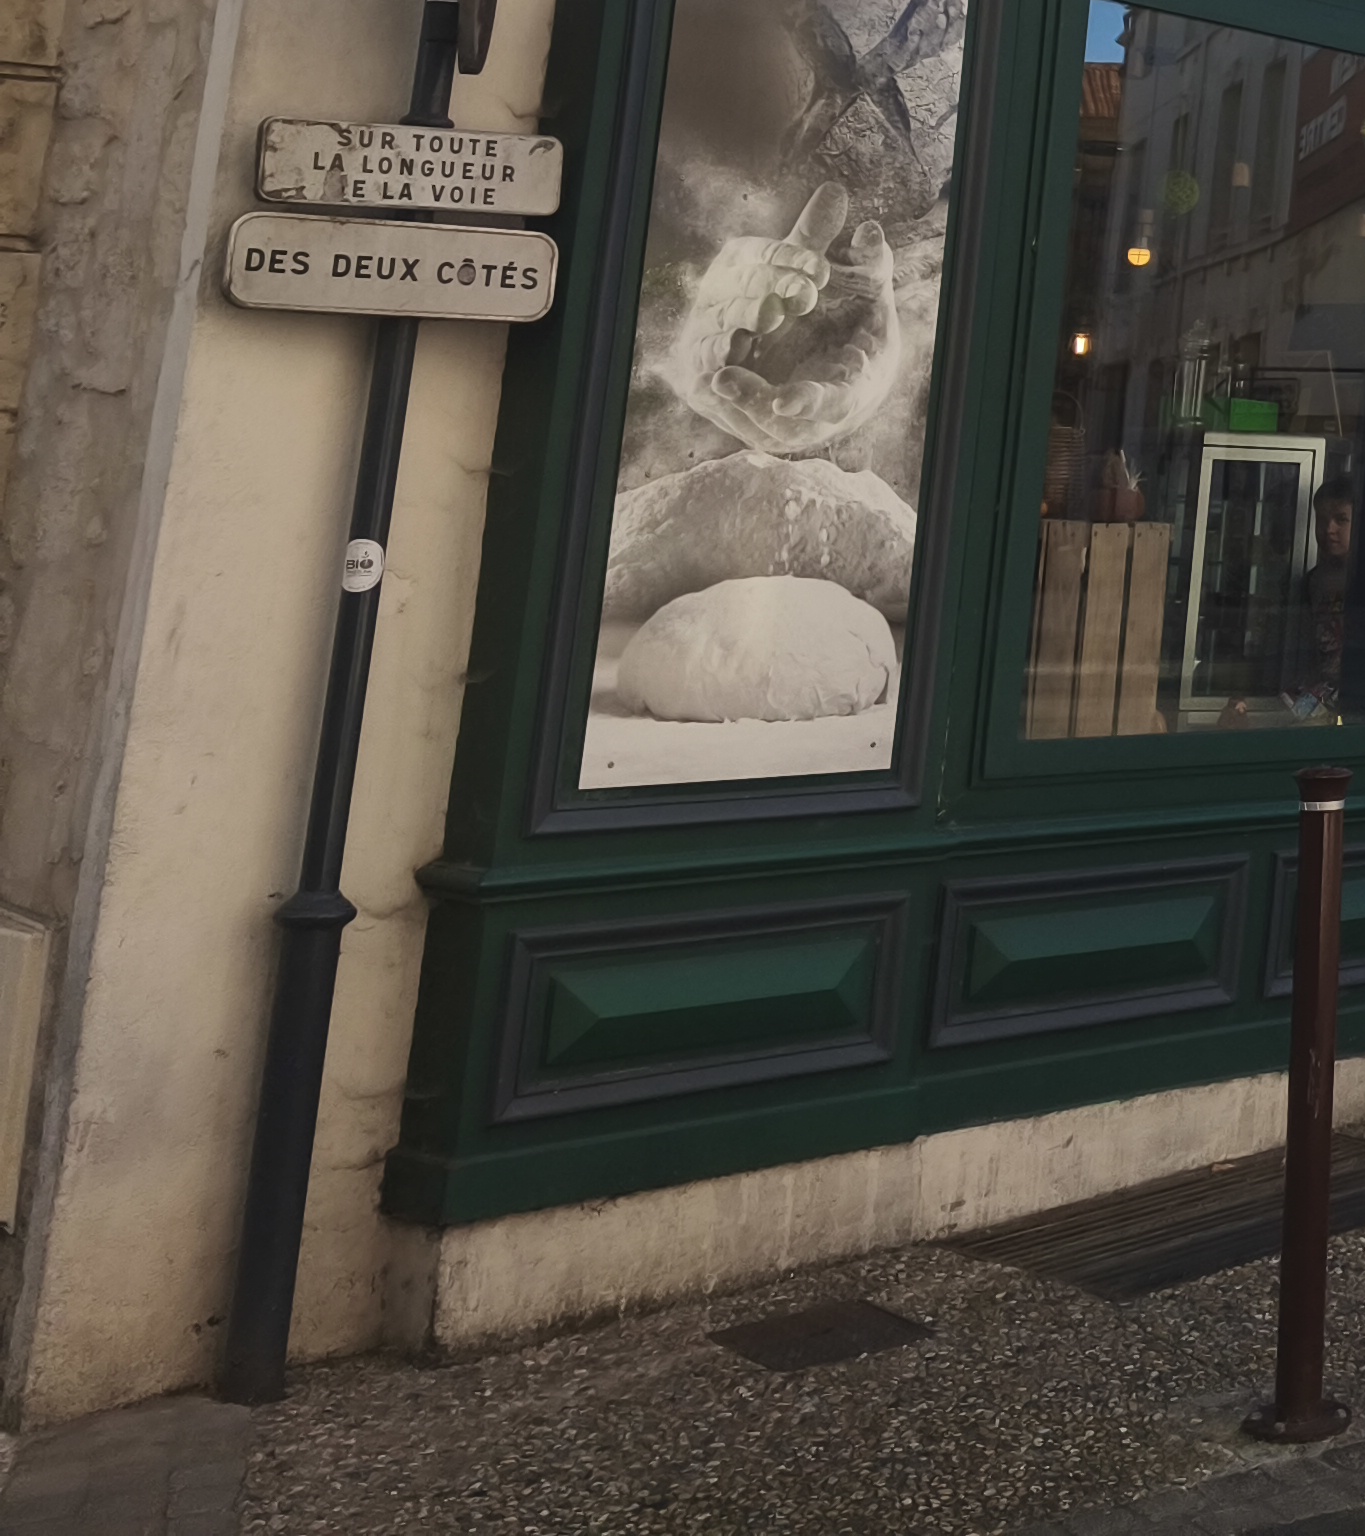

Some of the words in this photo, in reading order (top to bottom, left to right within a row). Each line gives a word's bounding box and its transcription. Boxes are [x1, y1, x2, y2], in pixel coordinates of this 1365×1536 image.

[337, 129, 397, 151] SUR
[412, 134, 498, 157] TOUTE
[313, 151, 345, 173] LA
[361, 155, 516, 183] LONGUEUR
[382, 181, 413, 201] LA
[431, 184, 497, 205] VOIE
[245, 247, 311, 276] DES
[332, 253, 421, 283] DEUX
[436, 258, 539, 291] CÔTÉS
